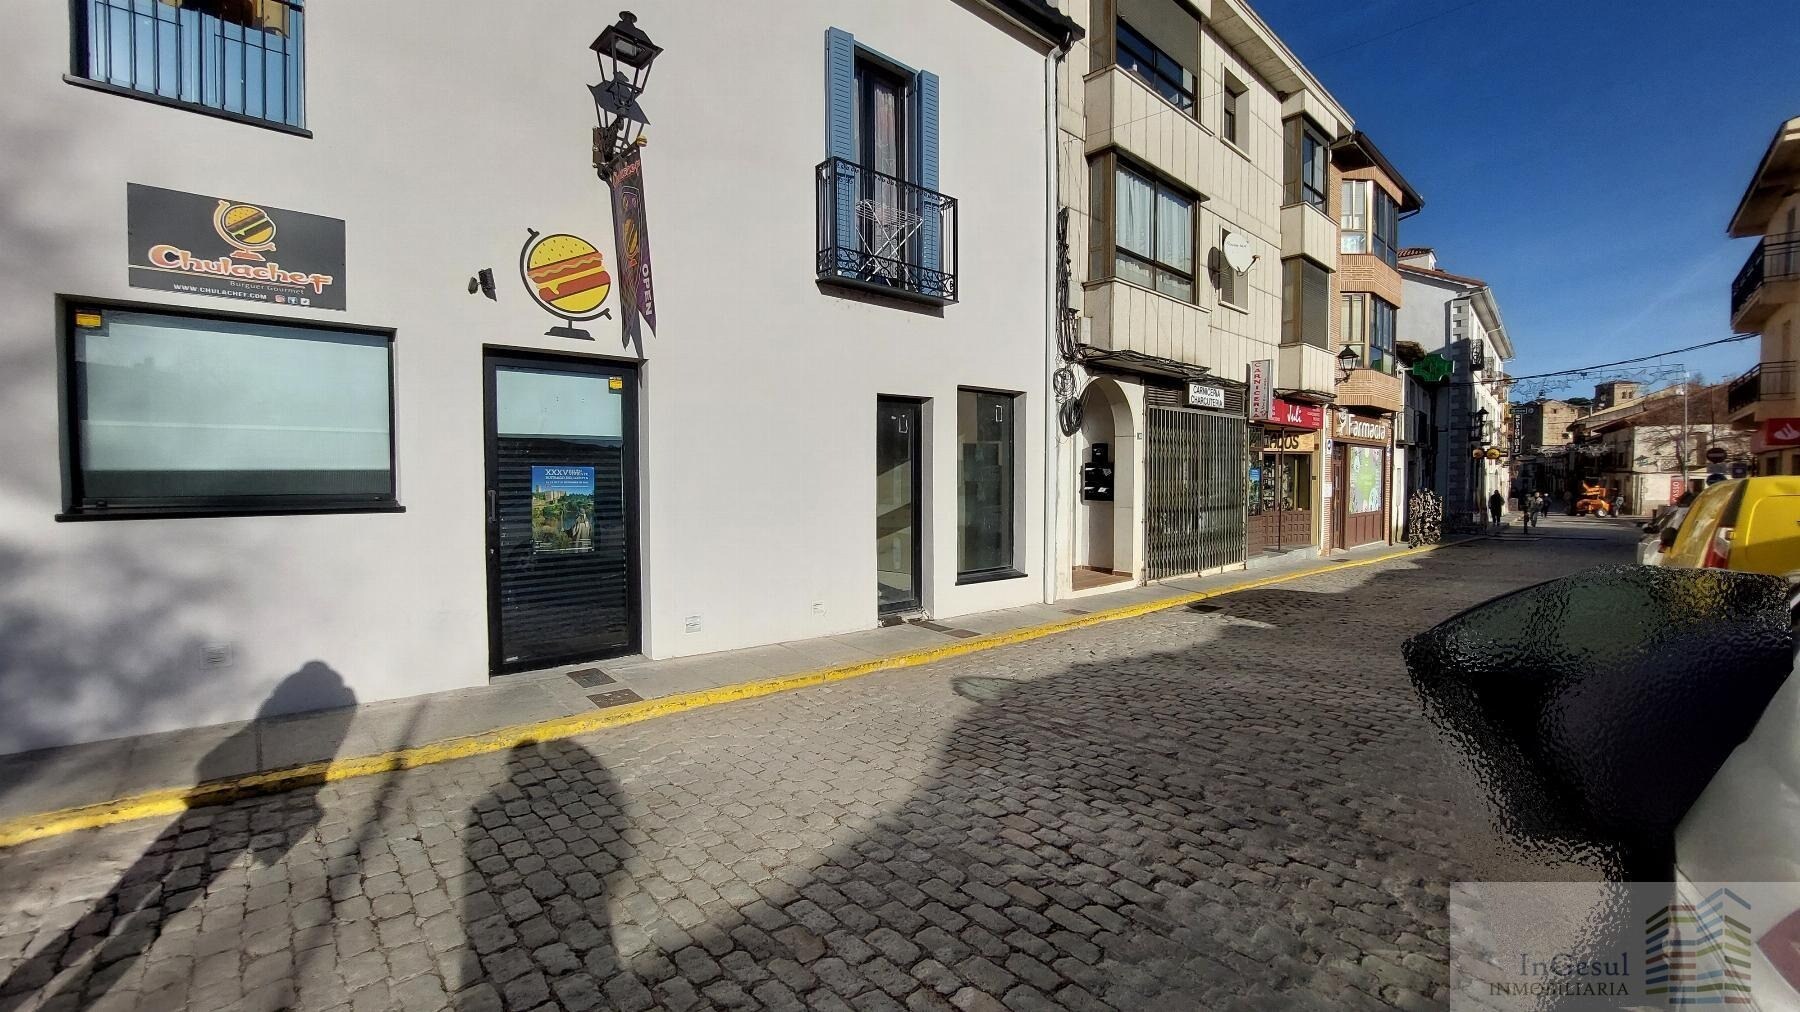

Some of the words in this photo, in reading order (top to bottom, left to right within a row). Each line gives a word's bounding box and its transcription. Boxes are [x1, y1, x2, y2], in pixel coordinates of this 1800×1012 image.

[148, 244, 333, 295] Chulachef
[230, 280, 264, 291] Burguer
[268, 284, 304, 295] Gourmet
[642, 263, 653, 316] OPEN
[1253, 362, 1262, 418] CARNICERIA
[1287, 405, 1302, 423] Juli
[1348, 413, 1386, 440] Farmacia
